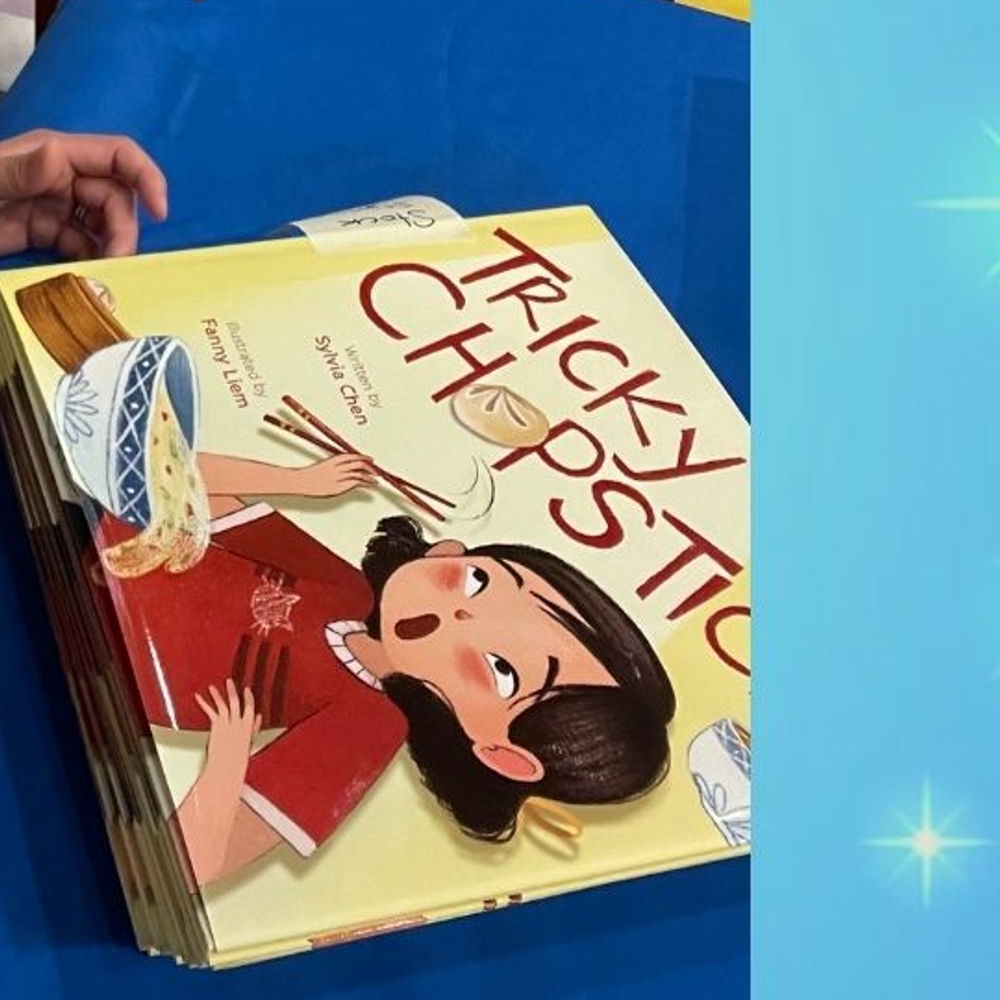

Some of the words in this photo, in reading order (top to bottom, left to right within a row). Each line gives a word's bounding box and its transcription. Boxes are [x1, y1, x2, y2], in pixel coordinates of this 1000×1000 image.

[202, 318, 231, 366] Fanny
[222, 367, 250, 410] Liem
[314, 334, 345, 380] Sylvia
[339, 383, 369, 427] Chen
[345, 344, 373, 392] Written
[367, 393, 383, 410] by
[459, 227, 747, 482] TRICKY
